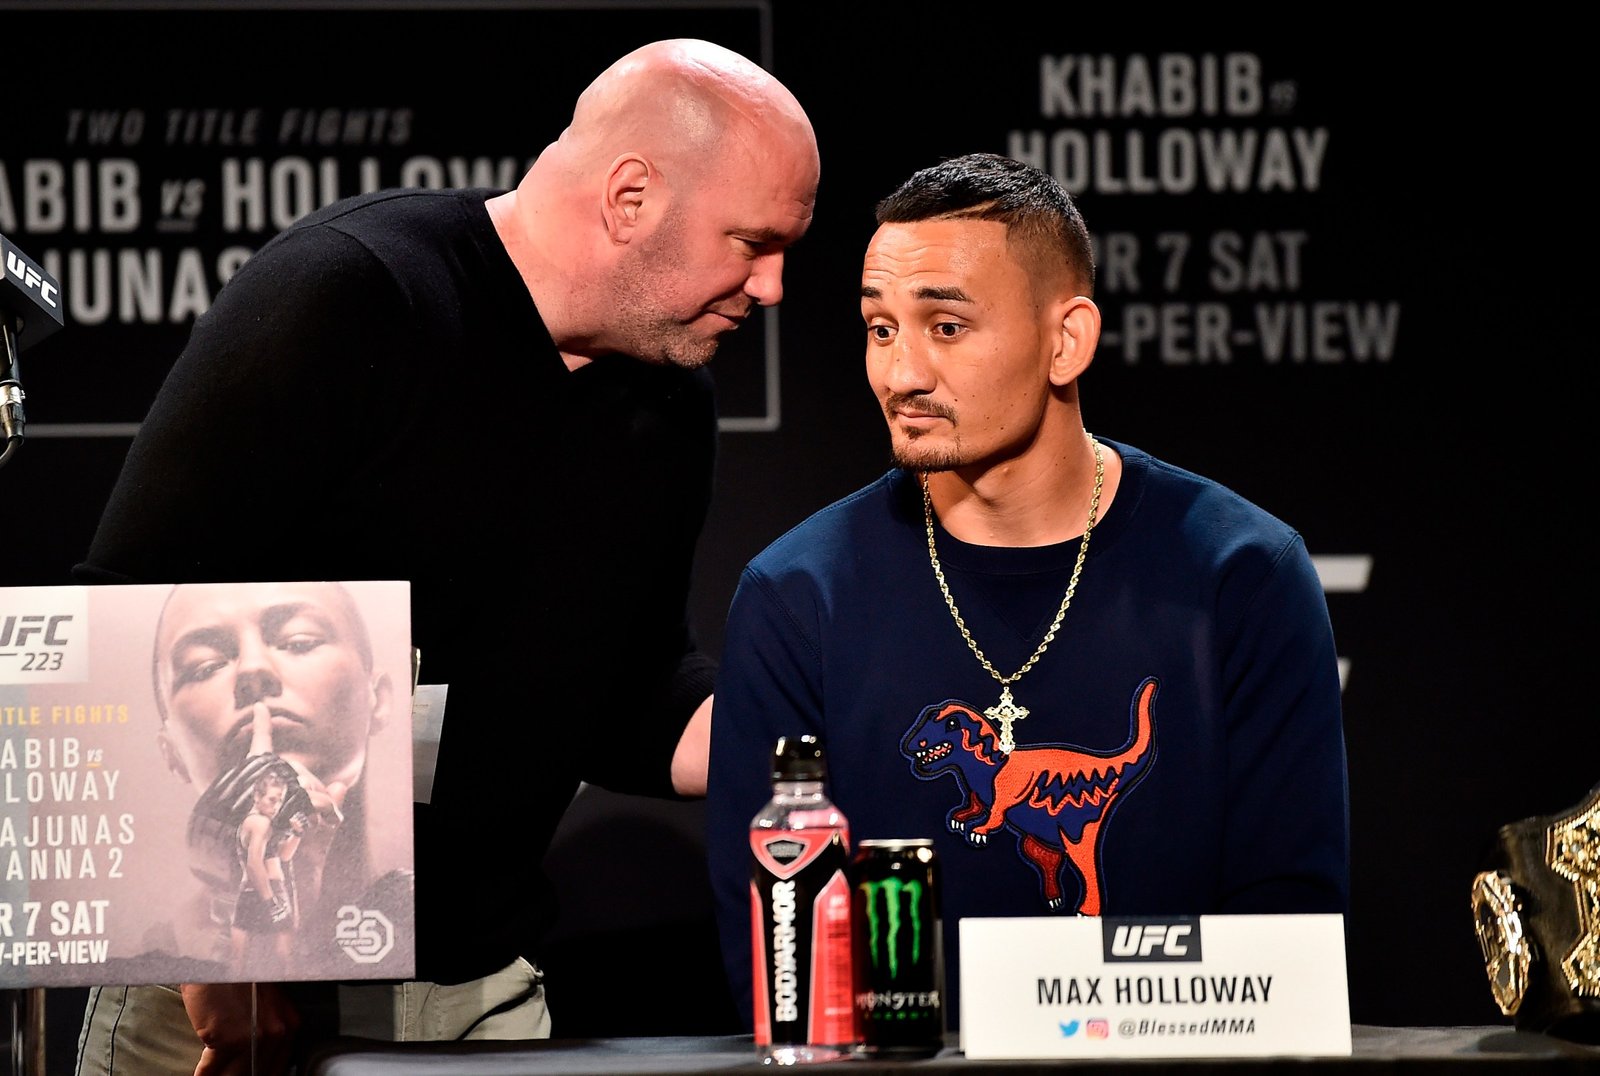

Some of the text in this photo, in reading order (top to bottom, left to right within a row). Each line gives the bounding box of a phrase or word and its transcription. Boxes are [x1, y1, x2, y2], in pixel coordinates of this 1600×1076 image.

[1038, 52, 1262, 118] KHABIB
[66, 108, 413, 146] TWO TITLE FIGHTS
[1007, 127, 1329, 194] HOLLOWAY
[7, 250, 57, 309] UFC
[1089, 230, 1309, 293] R 7 SAT
[21, 652, 64, 671] 223
[52, 703, 129, 725] FIGHTS
[108, 847, 124, 879] 2
[23, 901, 42, 937] 7
[50, 900, 111, 936] SAT
[772, 880, 798, 1023] BODYARMOR
[1111, 925, 1193, 957] UFC
[1036, 975, 1274, 1007] MAX HOLLOWAY
[1117, 1017, 1257, 1038] @BlessedMMA
